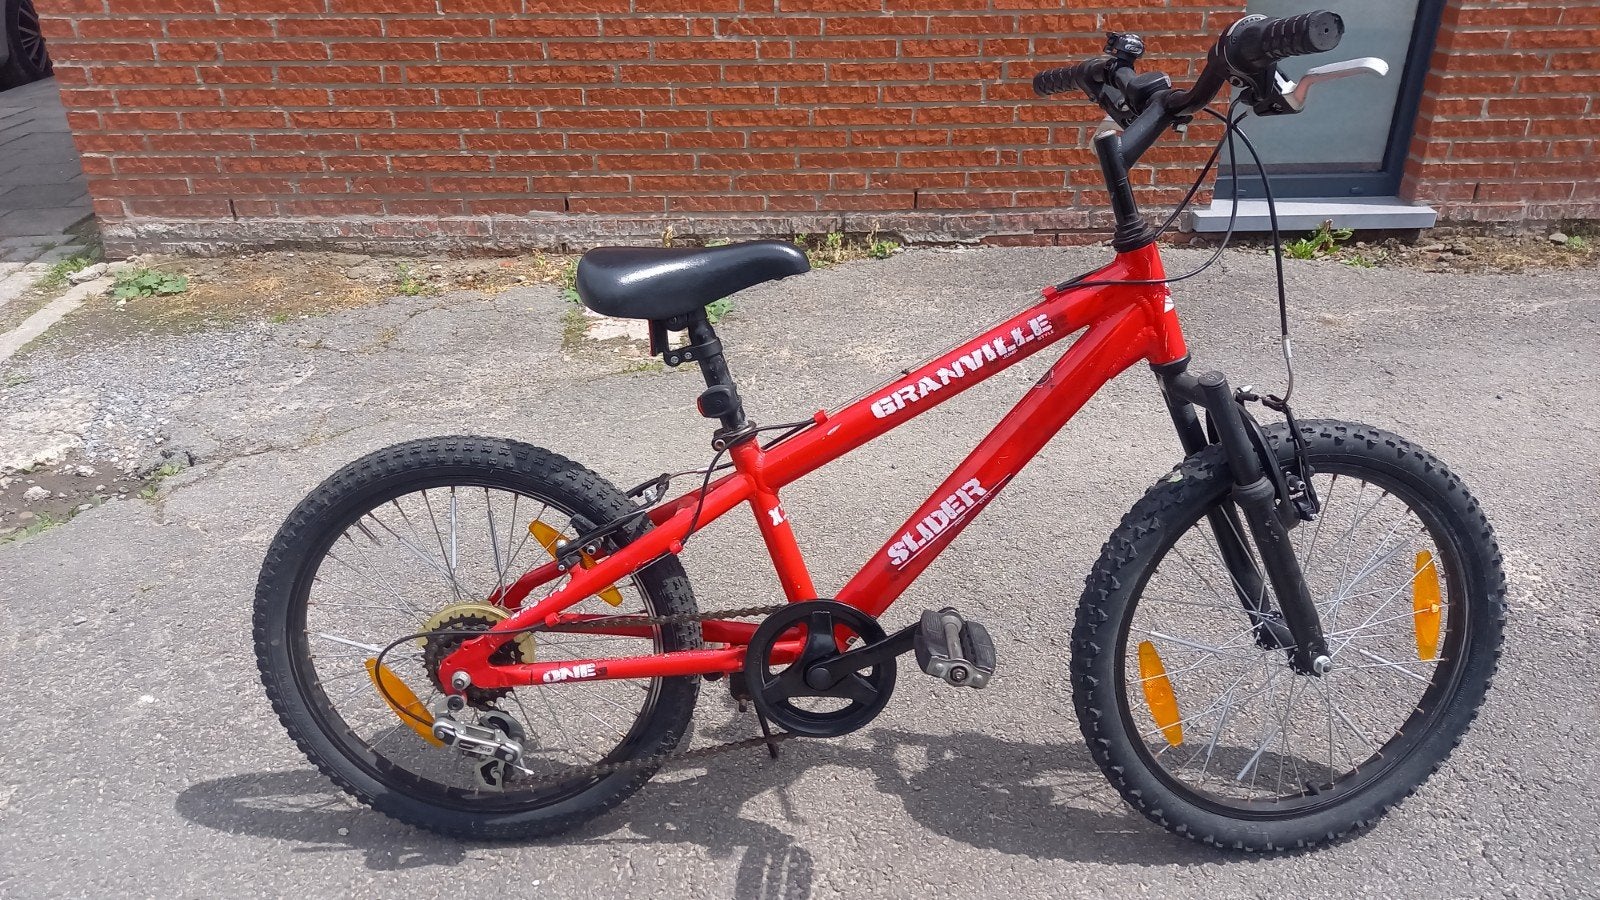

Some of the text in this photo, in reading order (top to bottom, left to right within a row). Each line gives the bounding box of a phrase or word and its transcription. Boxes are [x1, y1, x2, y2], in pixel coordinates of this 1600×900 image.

[1037, 329, 1055, 341] STYLE
[870, 313, 1054, 419] GRANVILLE
[887, 477, 988, 566] SLIDER
[542, 663, 597, 683] ONE
